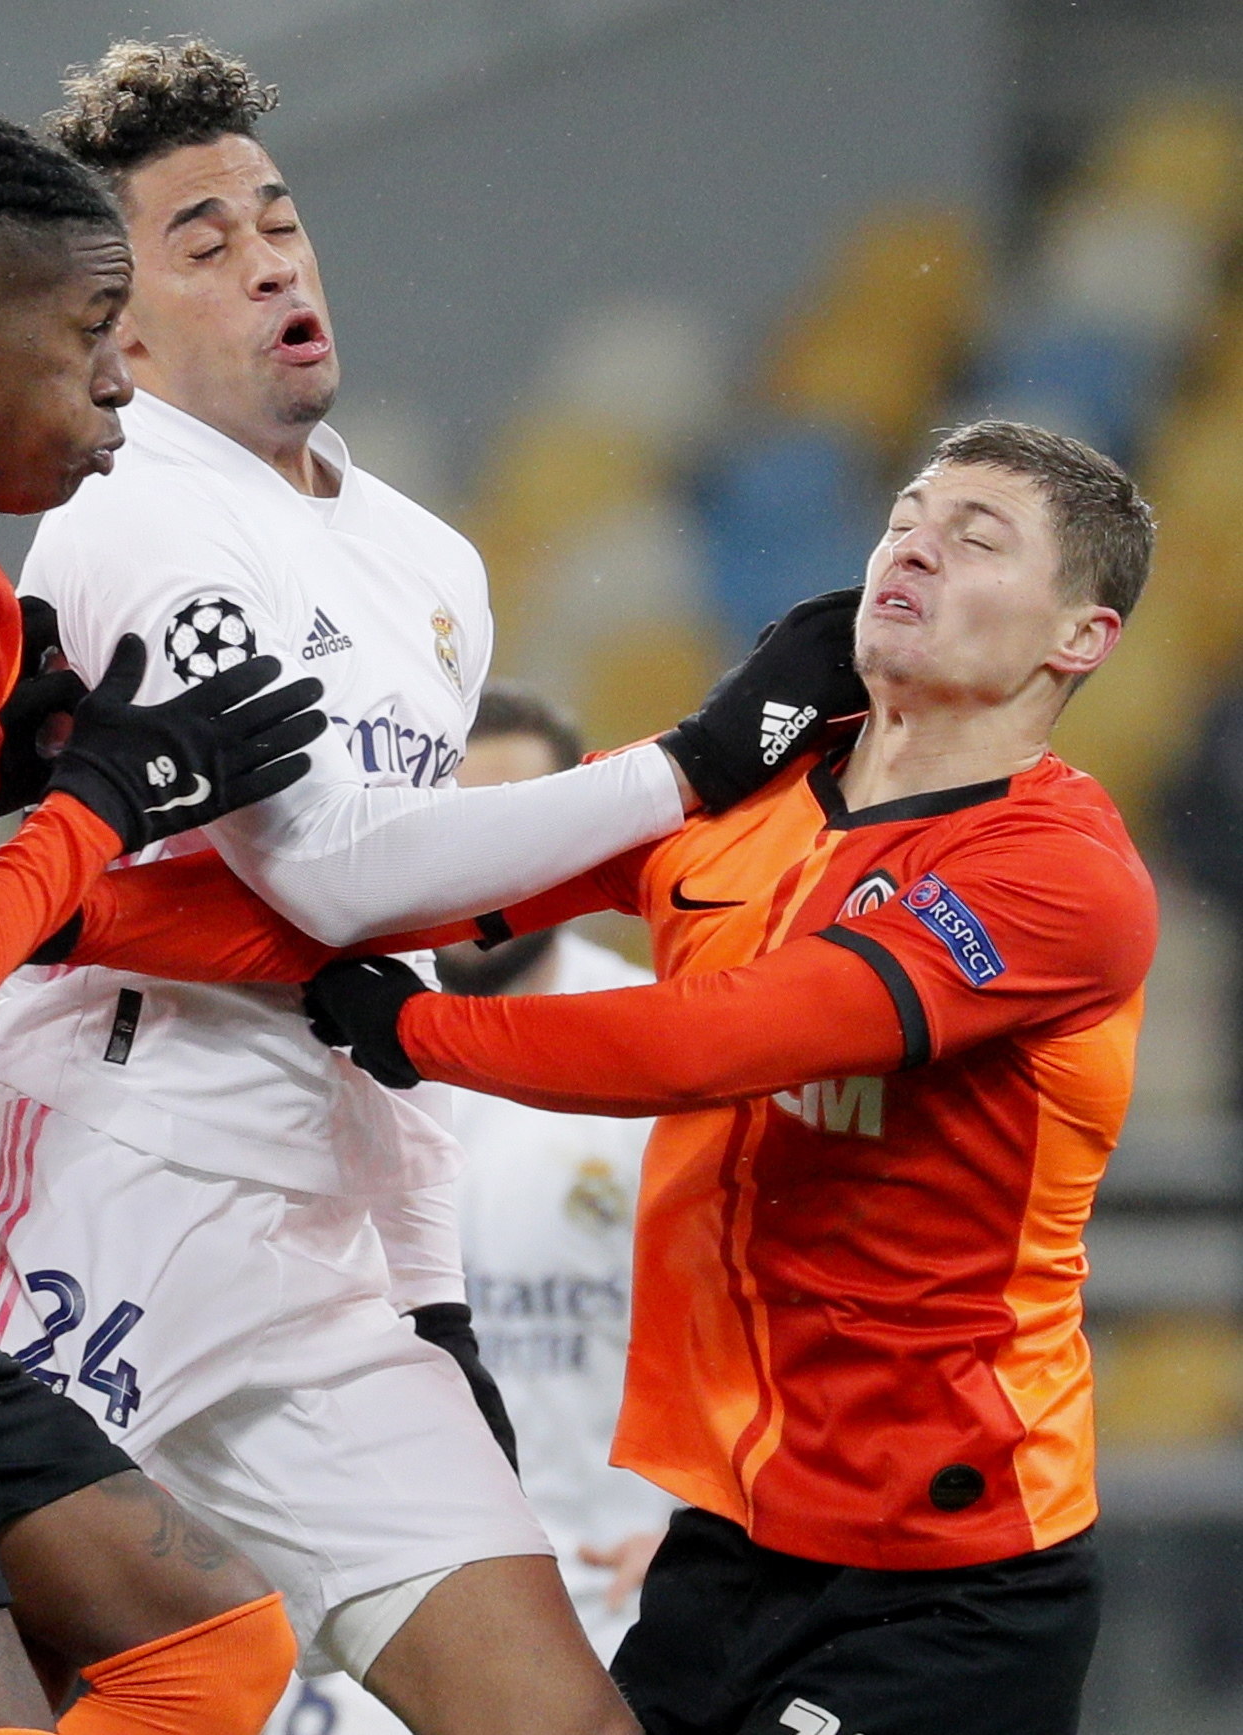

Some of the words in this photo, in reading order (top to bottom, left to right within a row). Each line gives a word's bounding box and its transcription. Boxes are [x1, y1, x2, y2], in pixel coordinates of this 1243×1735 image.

[302, 634, 353, 661] adidas
[762, 705, 818, 766] adidas
[146, 755, 177, 787] 49
[929, 900, 997, 978] RESPECT
[10, 1269, 145, 1429] 24
